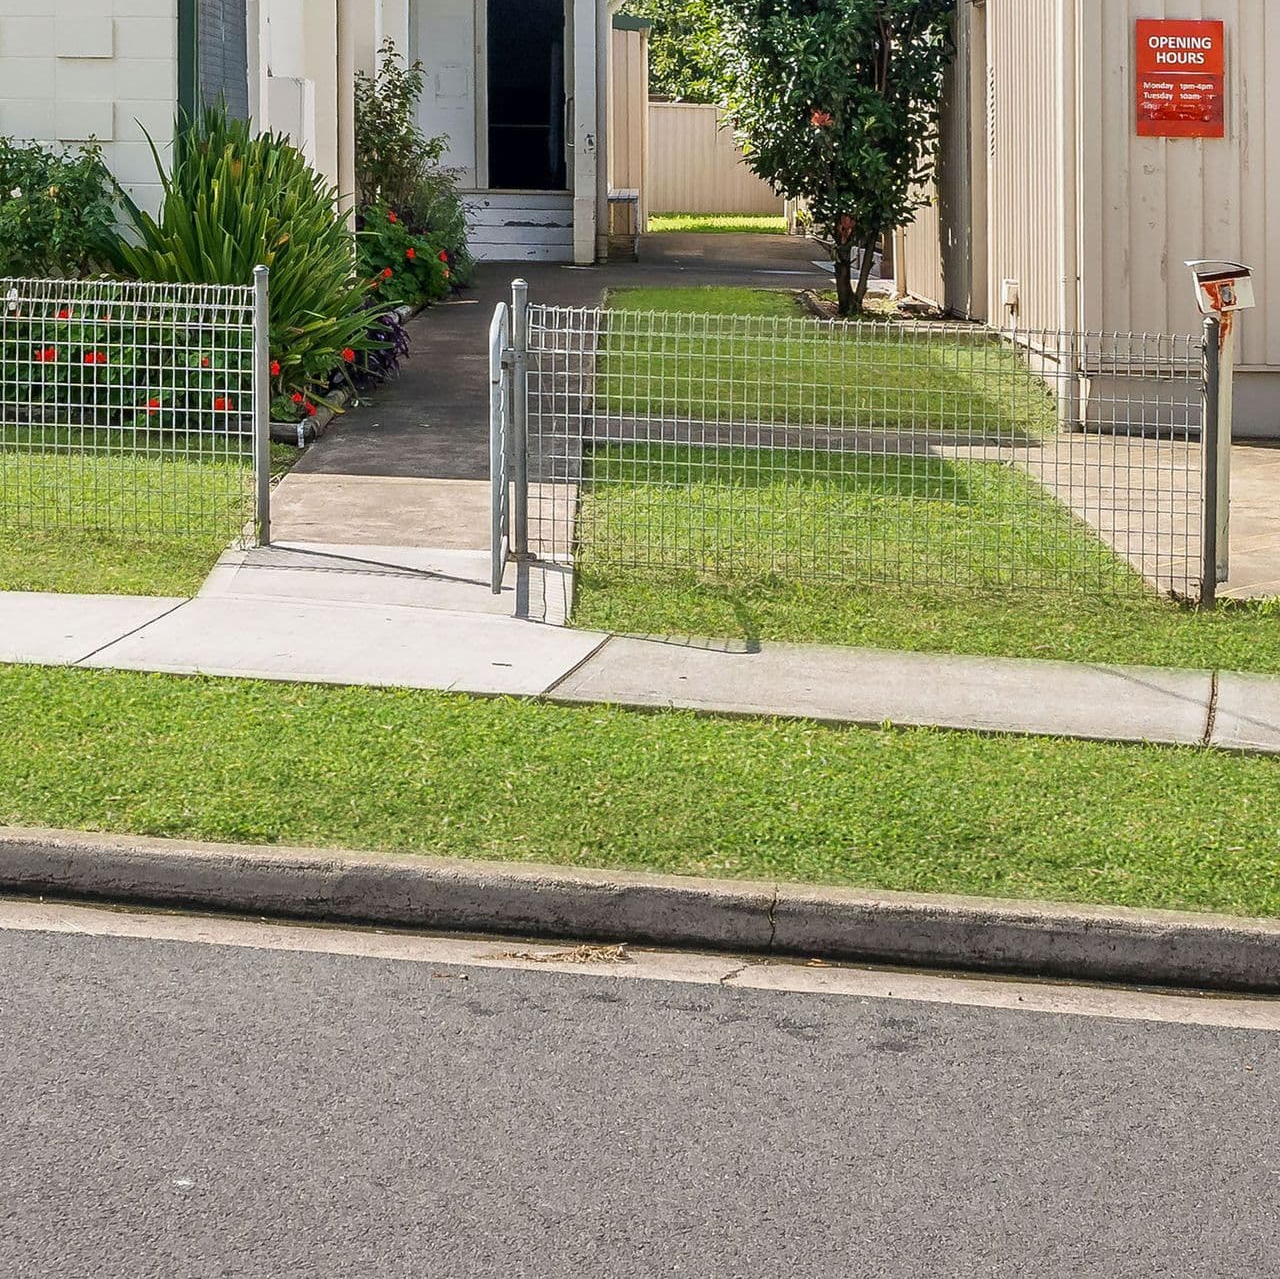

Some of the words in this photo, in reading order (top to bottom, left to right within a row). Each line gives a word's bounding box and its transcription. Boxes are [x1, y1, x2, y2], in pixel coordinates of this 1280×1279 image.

[1148, 36, 1212, 49] OPENING
[1156, 51, 1205, 64] HOURS
[1143, 82, 1174, 90] Monday
[1143, 92, 1173, 100] Tuesday
